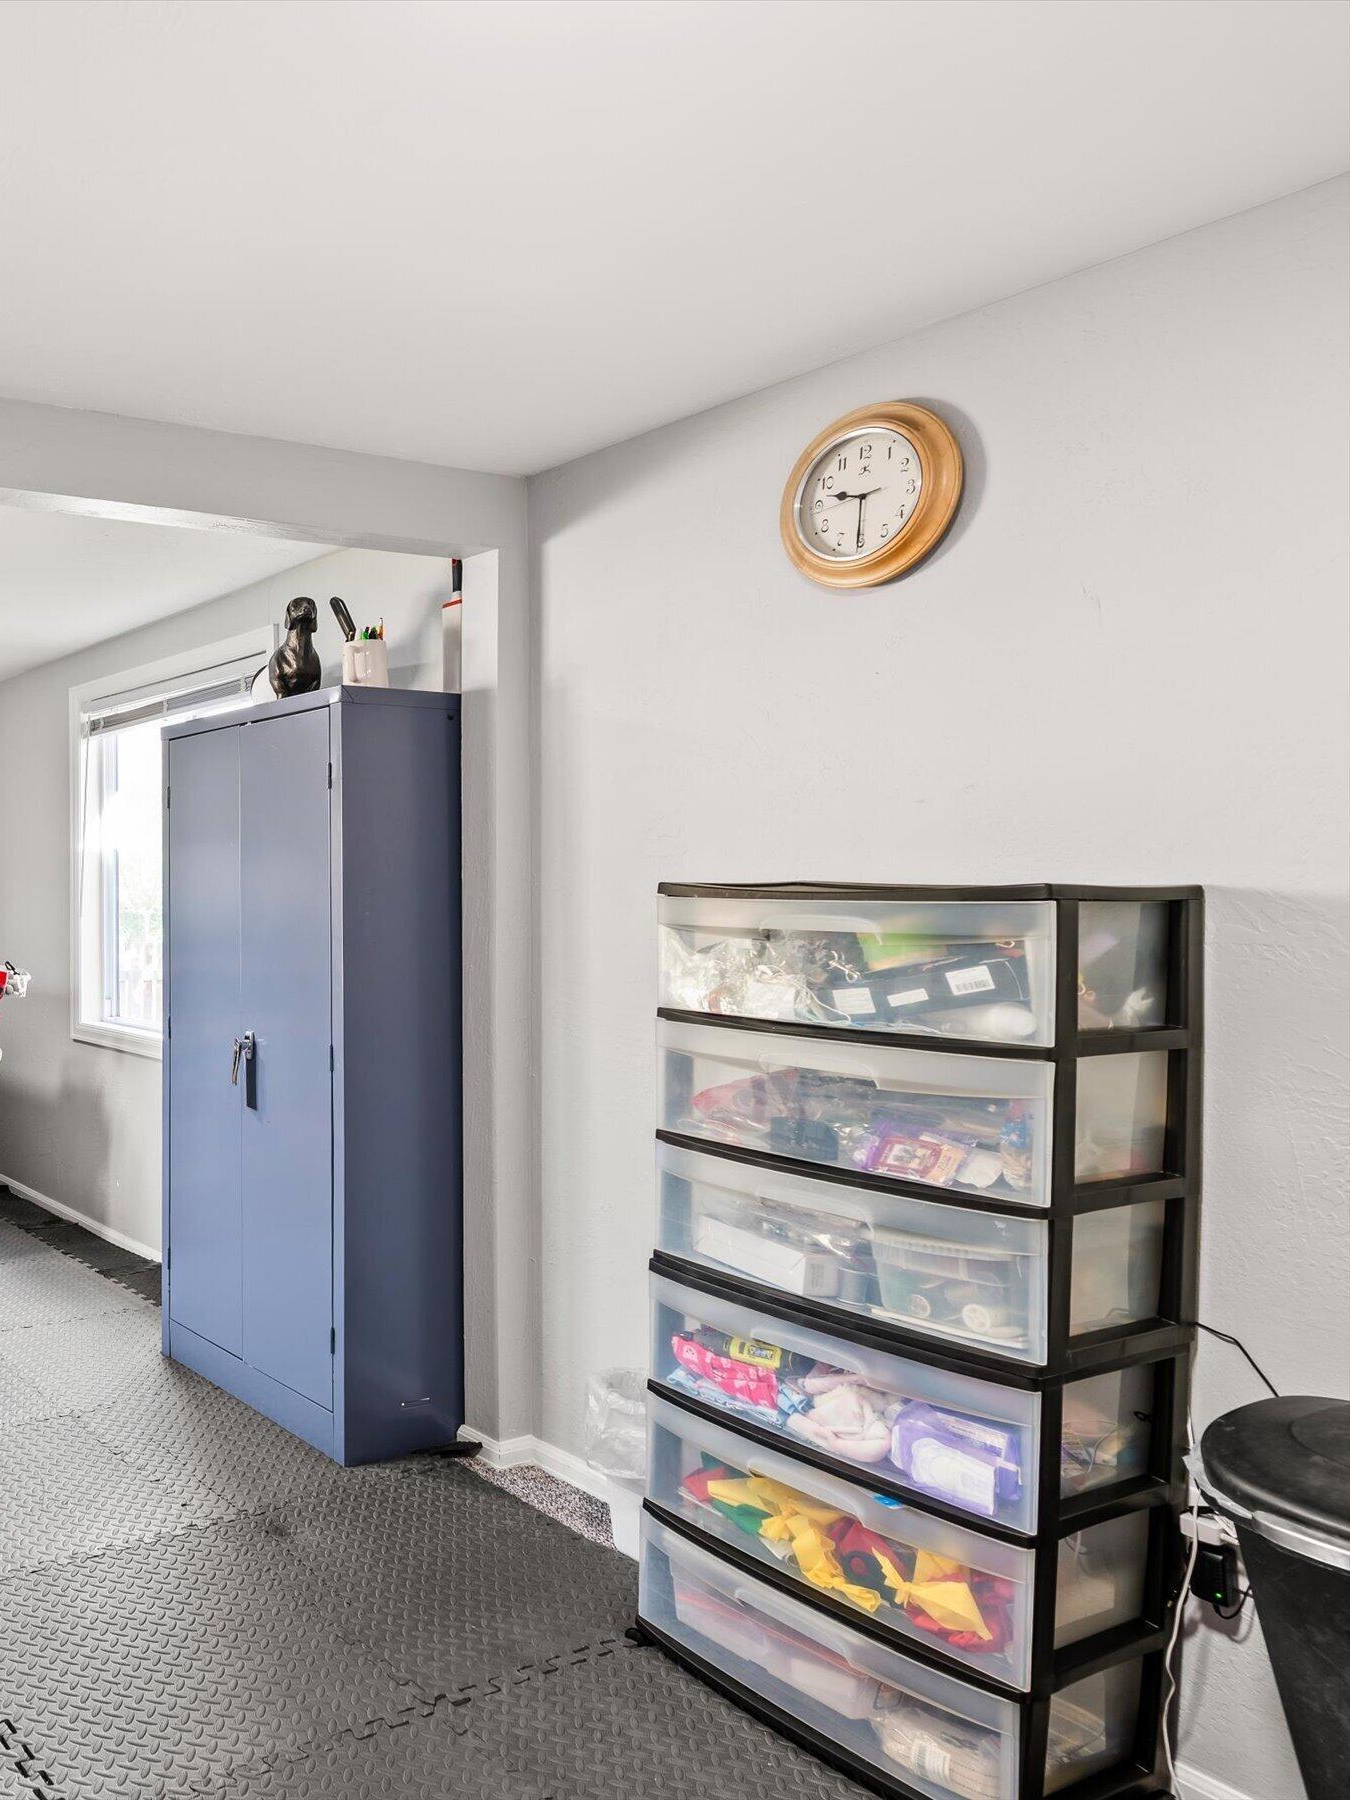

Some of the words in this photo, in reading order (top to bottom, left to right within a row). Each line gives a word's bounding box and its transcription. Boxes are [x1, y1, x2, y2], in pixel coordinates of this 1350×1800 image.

[859, 445, 872, 460] 12
[887, 446, 893, 460] 1
[838, 457, 847, 471] 11
[900, 457, 910, 473] 2
[822, 476, 834, 490] 10
[906, 479, 916, 494] 3
[814, 499, 824, 514] 9
[894, 504, 906, 519] 4
[820, 518, 829, 533] 8
[880, 523, 889, 538] 5
[836, 532, 845, 547] 7
